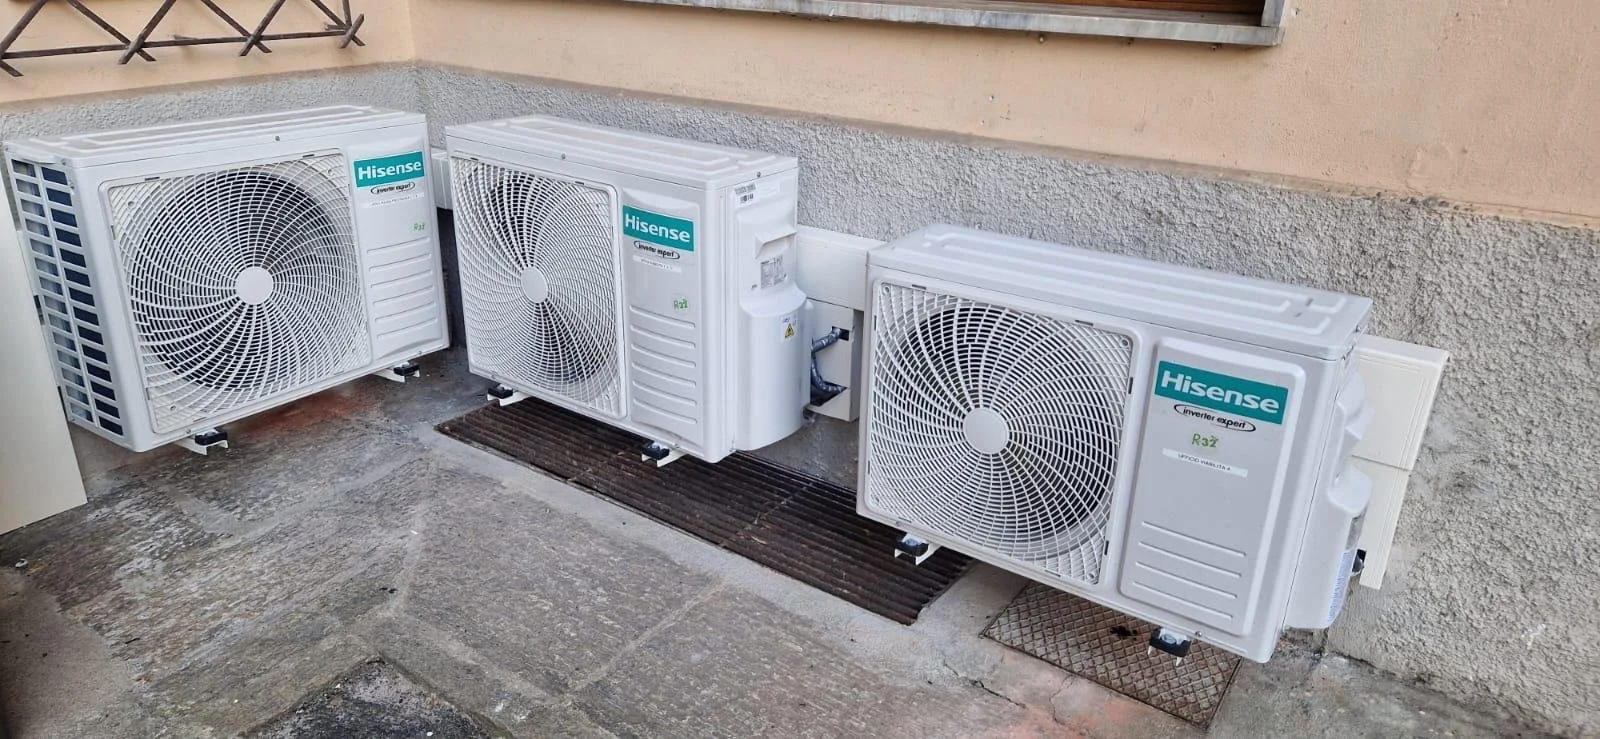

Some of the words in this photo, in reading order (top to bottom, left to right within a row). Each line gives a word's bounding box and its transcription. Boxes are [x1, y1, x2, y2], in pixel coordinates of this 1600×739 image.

[358, 161, 422, 180] Hisense
[625, 213, 691, 243] Hisense
[638, 244, 656, 253] inverter
[657, 249, 674, 258] expert
[1161, 370, 1279, 414] Hisense
[1183, 407, 1215, 421] inverter
[1217, 416, 1246, 429] expert
[1191, 433, 1219, 448] R32
